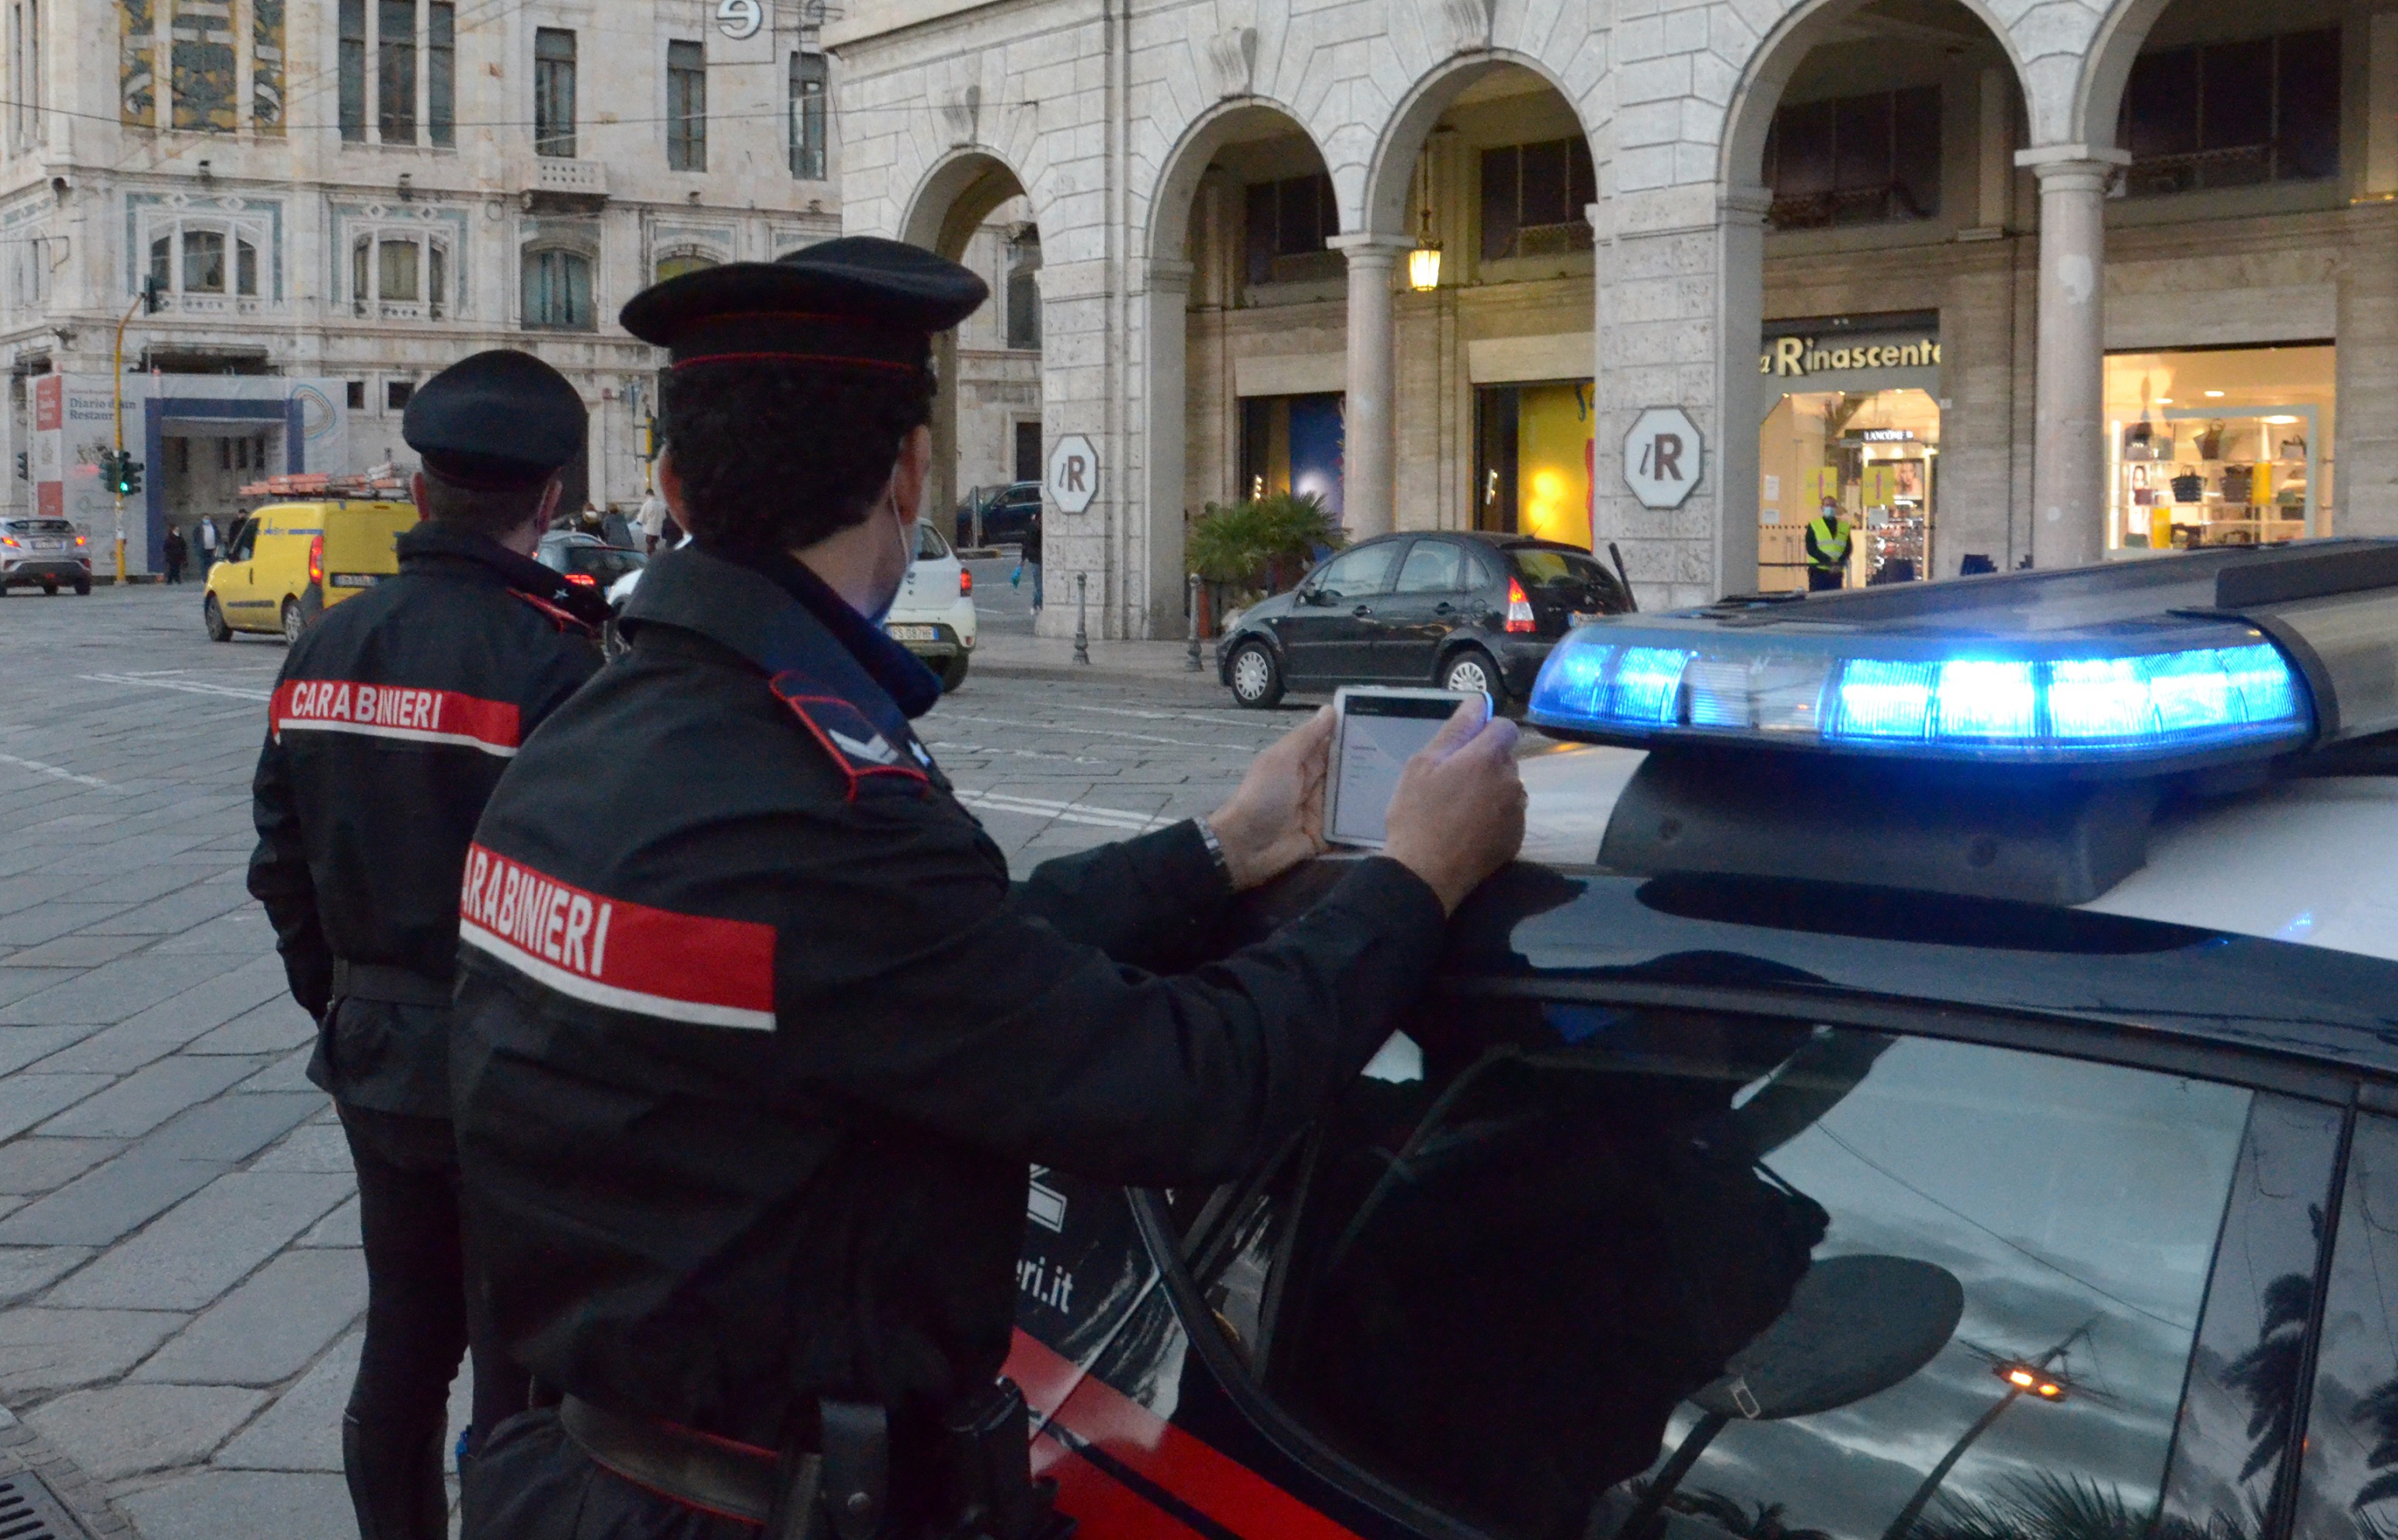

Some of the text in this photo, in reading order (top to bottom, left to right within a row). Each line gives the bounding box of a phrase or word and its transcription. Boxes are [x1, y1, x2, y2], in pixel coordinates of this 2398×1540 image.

[70, 397, 106, 409] Diario
[70, 410, 116, 421] Restaur
[291, 682, 443, 729] CARABINIERI
